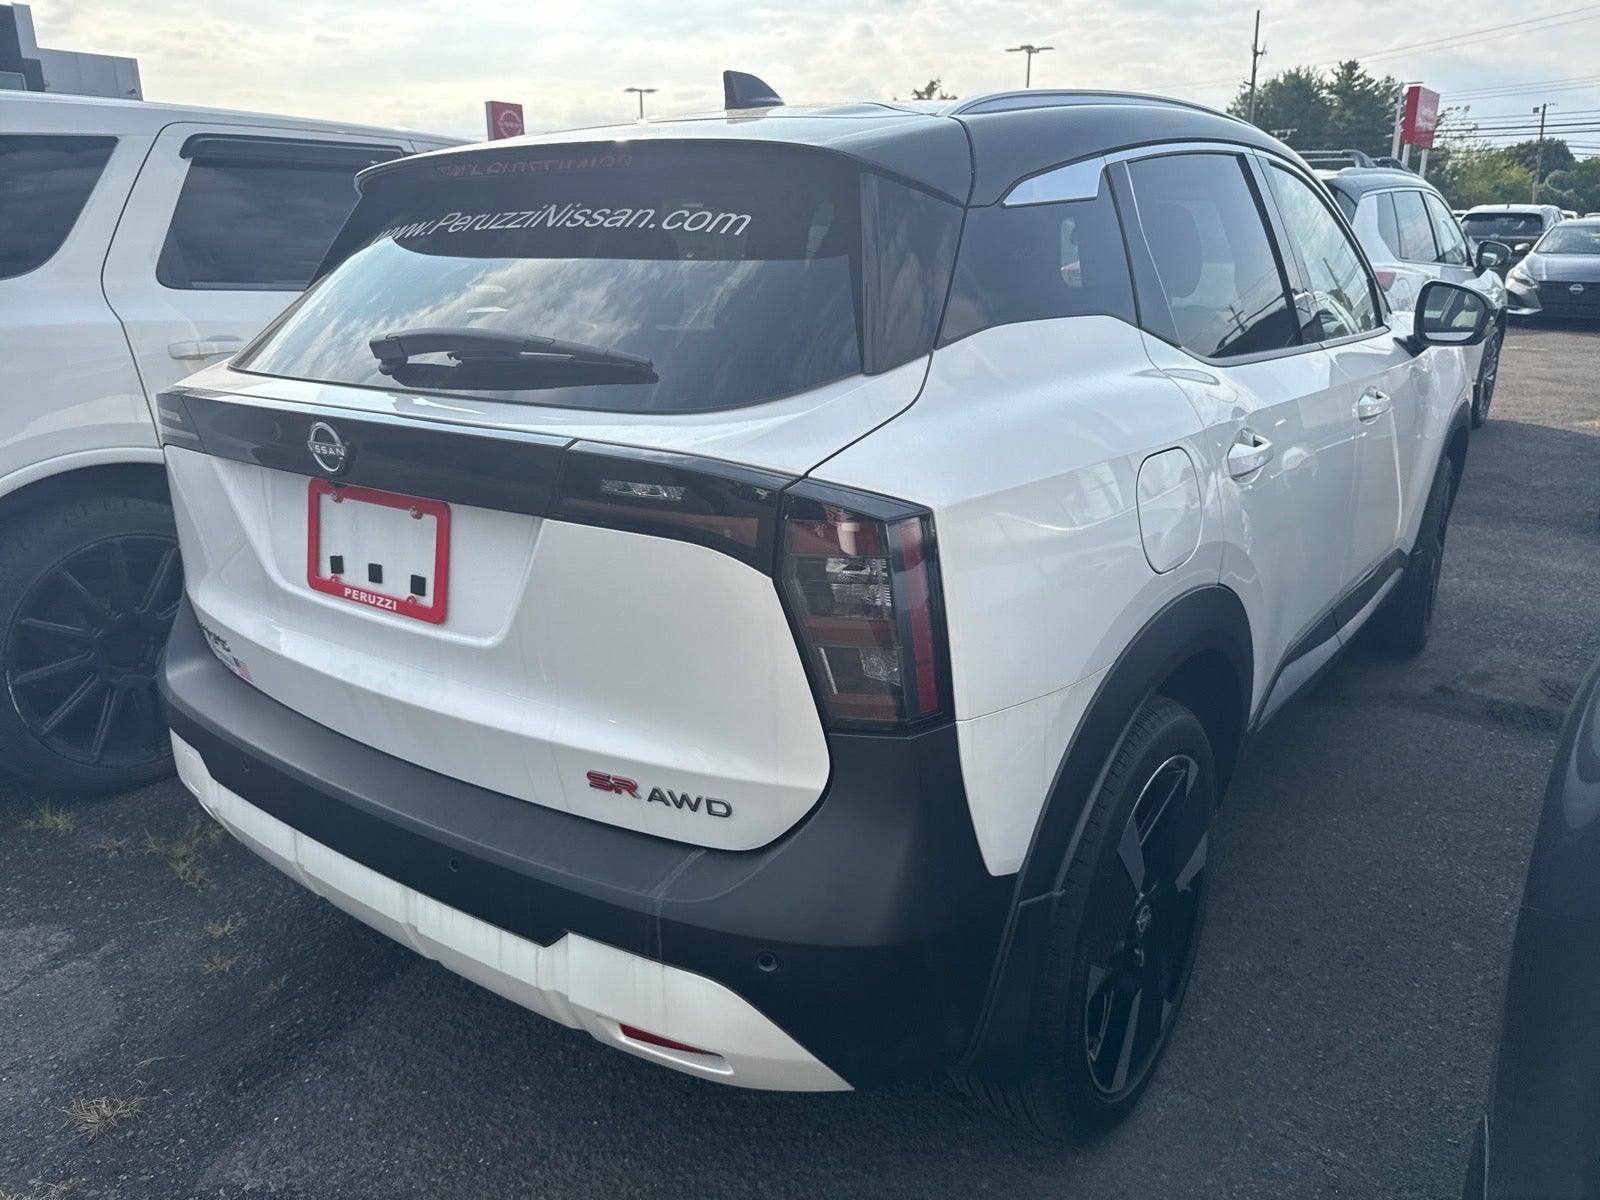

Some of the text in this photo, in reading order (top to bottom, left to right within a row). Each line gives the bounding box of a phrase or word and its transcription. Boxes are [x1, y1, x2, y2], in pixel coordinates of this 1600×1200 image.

[370, 203, 752, 246] www.PeruzziNissan.com
[344, 587, 397, 611] PERUZZI
[586, 769, 733, 818] SR AWD
